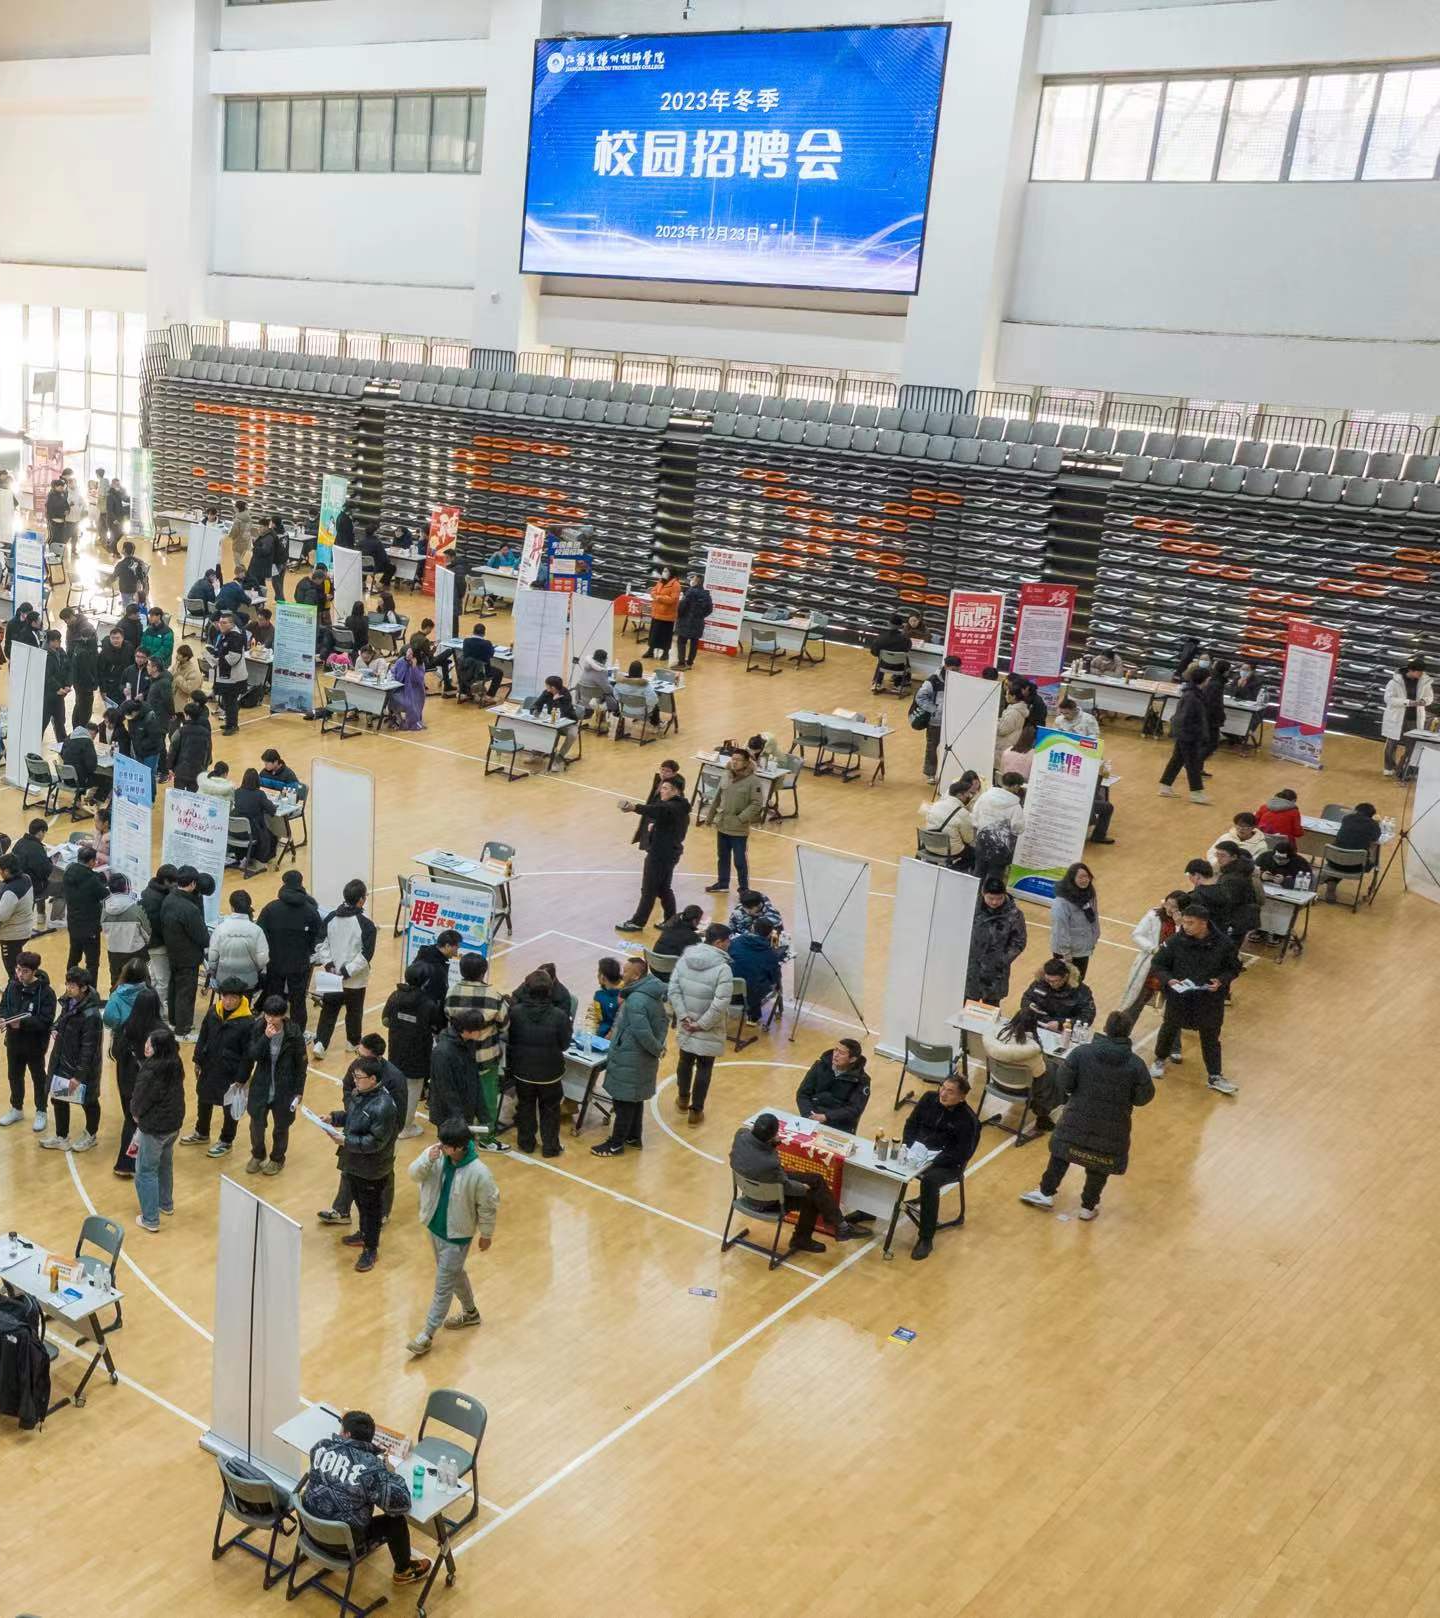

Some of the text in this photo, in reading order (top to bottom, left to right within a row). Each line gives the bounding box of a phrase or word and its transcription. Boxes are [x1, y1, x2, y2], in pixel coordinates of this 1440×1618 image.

[660, 88, 779, 112] 2023年冬季
[593, 128, 843, 180] 校园招聘会
[655, 224, 760, 243] 2023年12月23日
[411, 900, 439, 927] 聘
